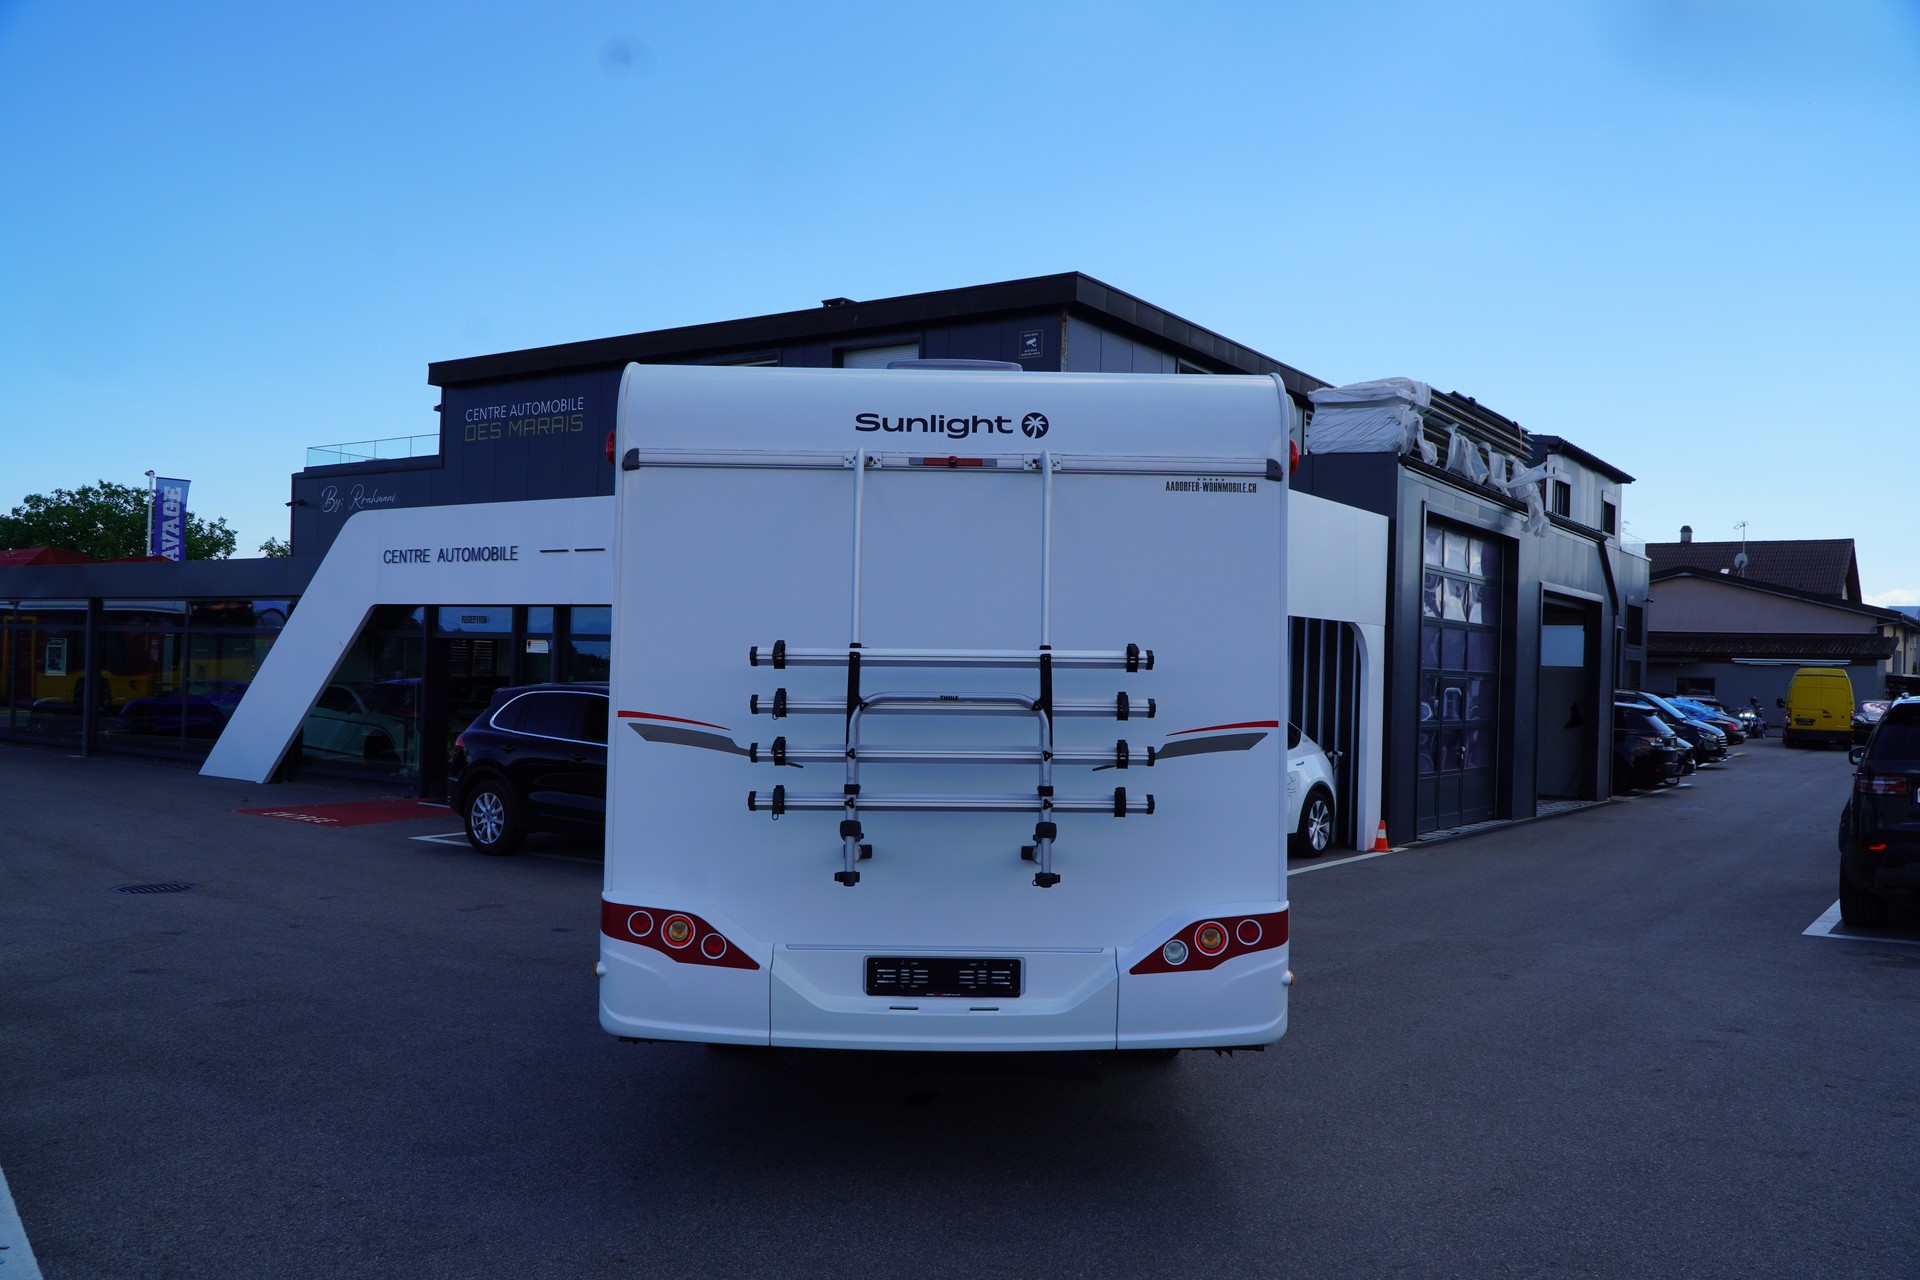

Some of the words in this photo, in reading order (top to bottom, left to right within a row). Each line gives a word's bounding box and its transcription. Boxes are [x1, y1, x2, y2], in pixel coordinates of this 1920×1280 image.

[465, 405, 506, 422] CENTRE
[509, 396, 584, 417] AUTOMOBILE
[464, 421, 502, 442] DES
[508, 414, 583, 438] MARAIS
[855, 413, 1013, 439] Sunlight
[321, 485, 345, 513] By:
[1165, 481, 1257, 493] AADORFER-WOHNMOBILE.CH
[161, 485, 182, 562] AVAGE
[383, 548, 430, 565] CENTRE
[437, 545, 519, 563] AUTOMOBILE
